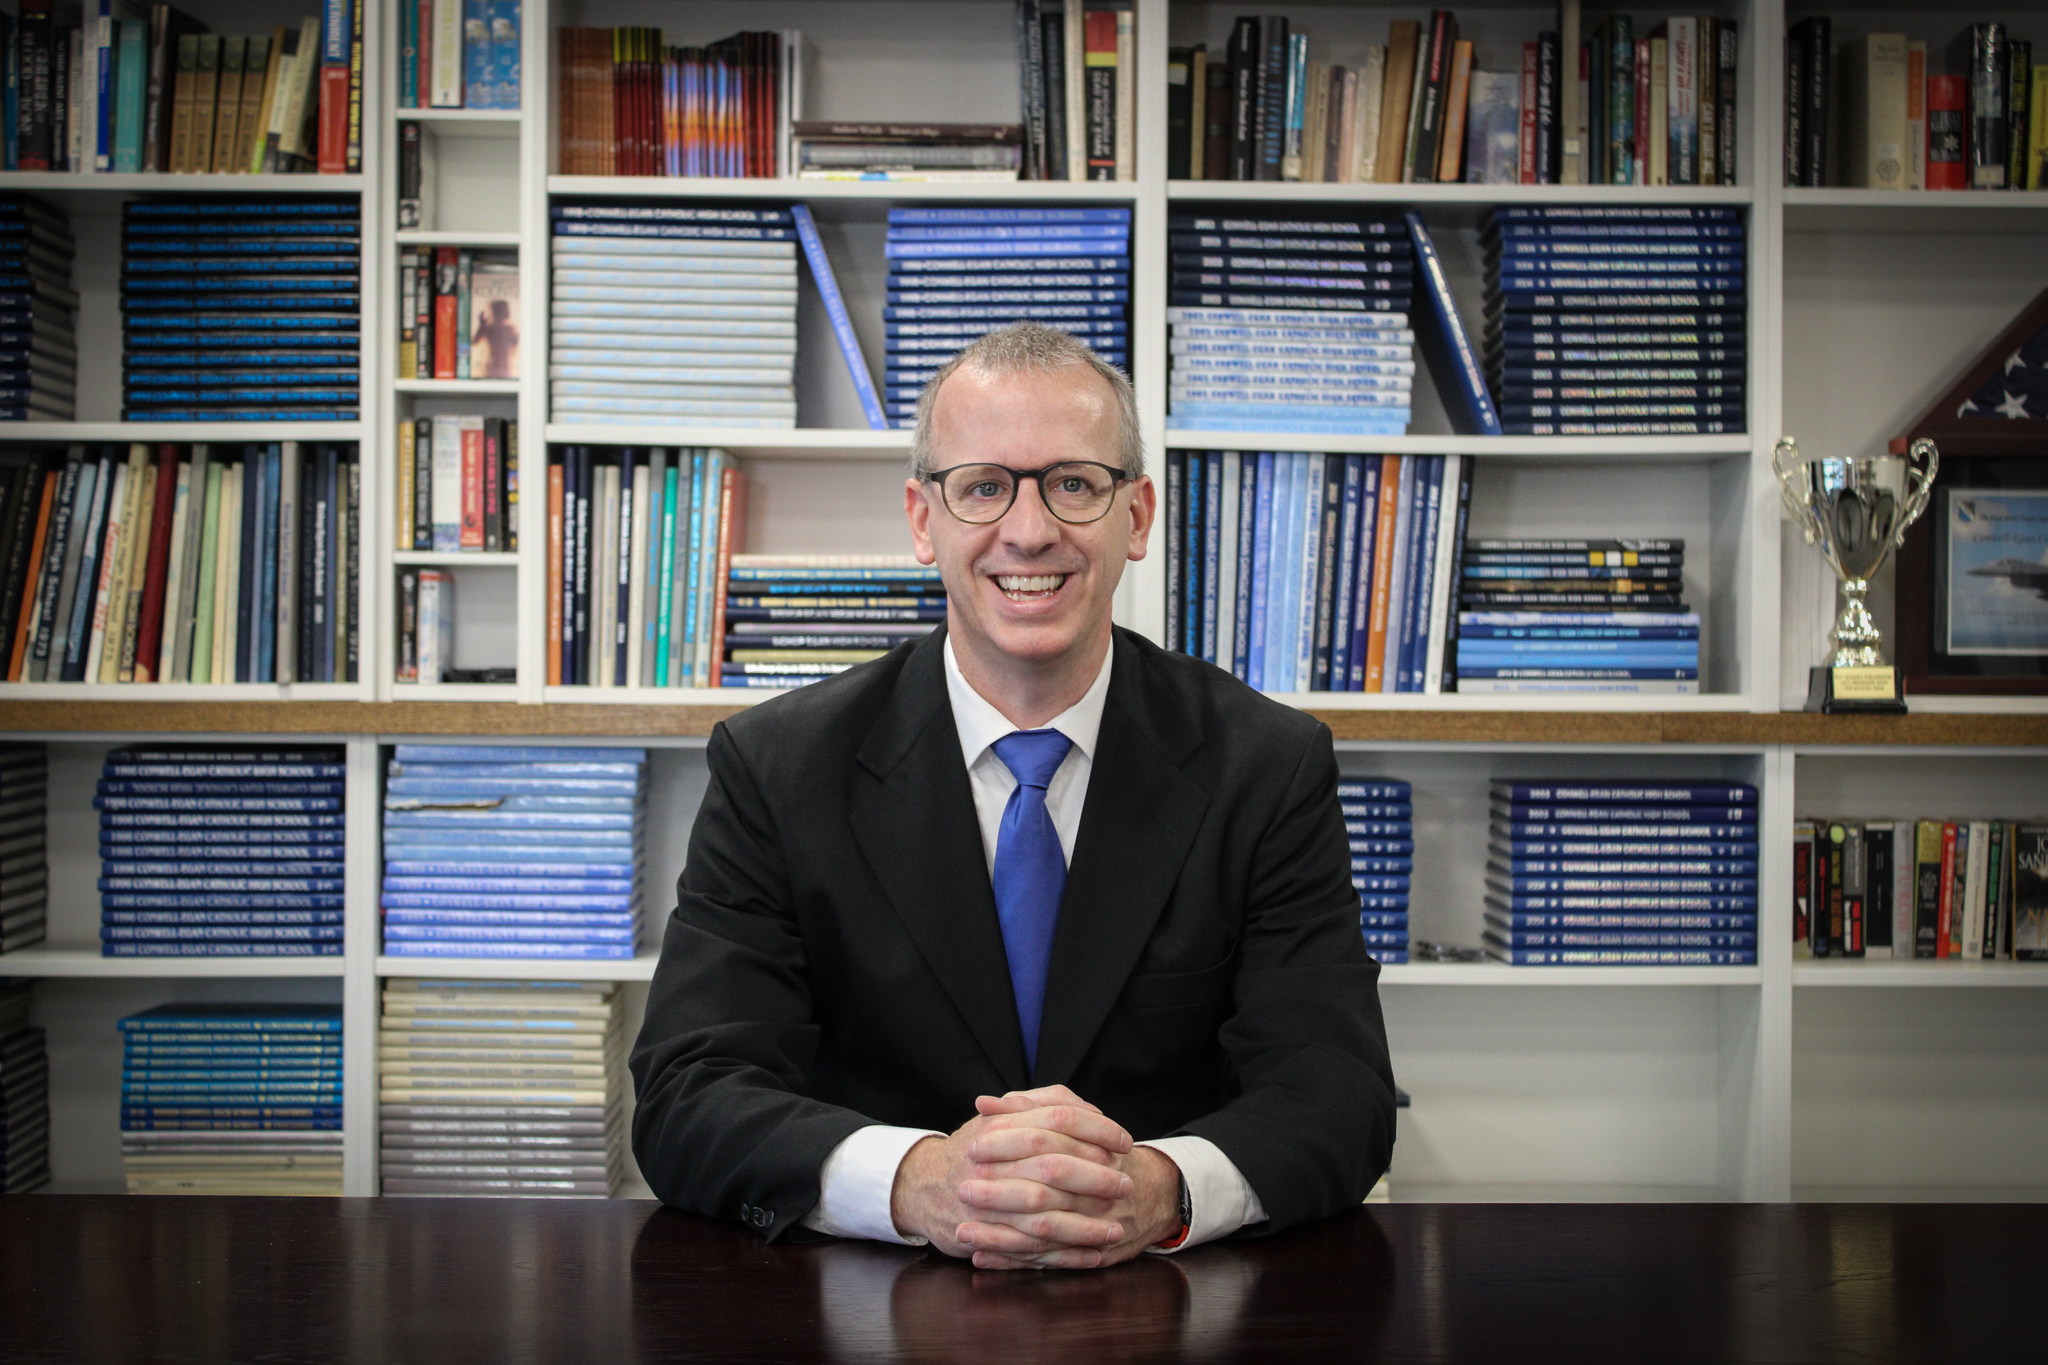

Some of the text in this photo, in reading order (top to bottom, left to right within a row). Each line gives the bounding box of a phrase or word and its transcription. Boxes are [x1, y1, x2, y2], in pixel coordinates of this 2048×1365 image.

[34, 461, 79, 657] Bishop Egan High School 1973
[115, 547, 130, 575] High
[110, 579, 124, 624] School
[2019, 851, 2048, 871] SAN
[1898, 864, 1914, 934] TUROW
